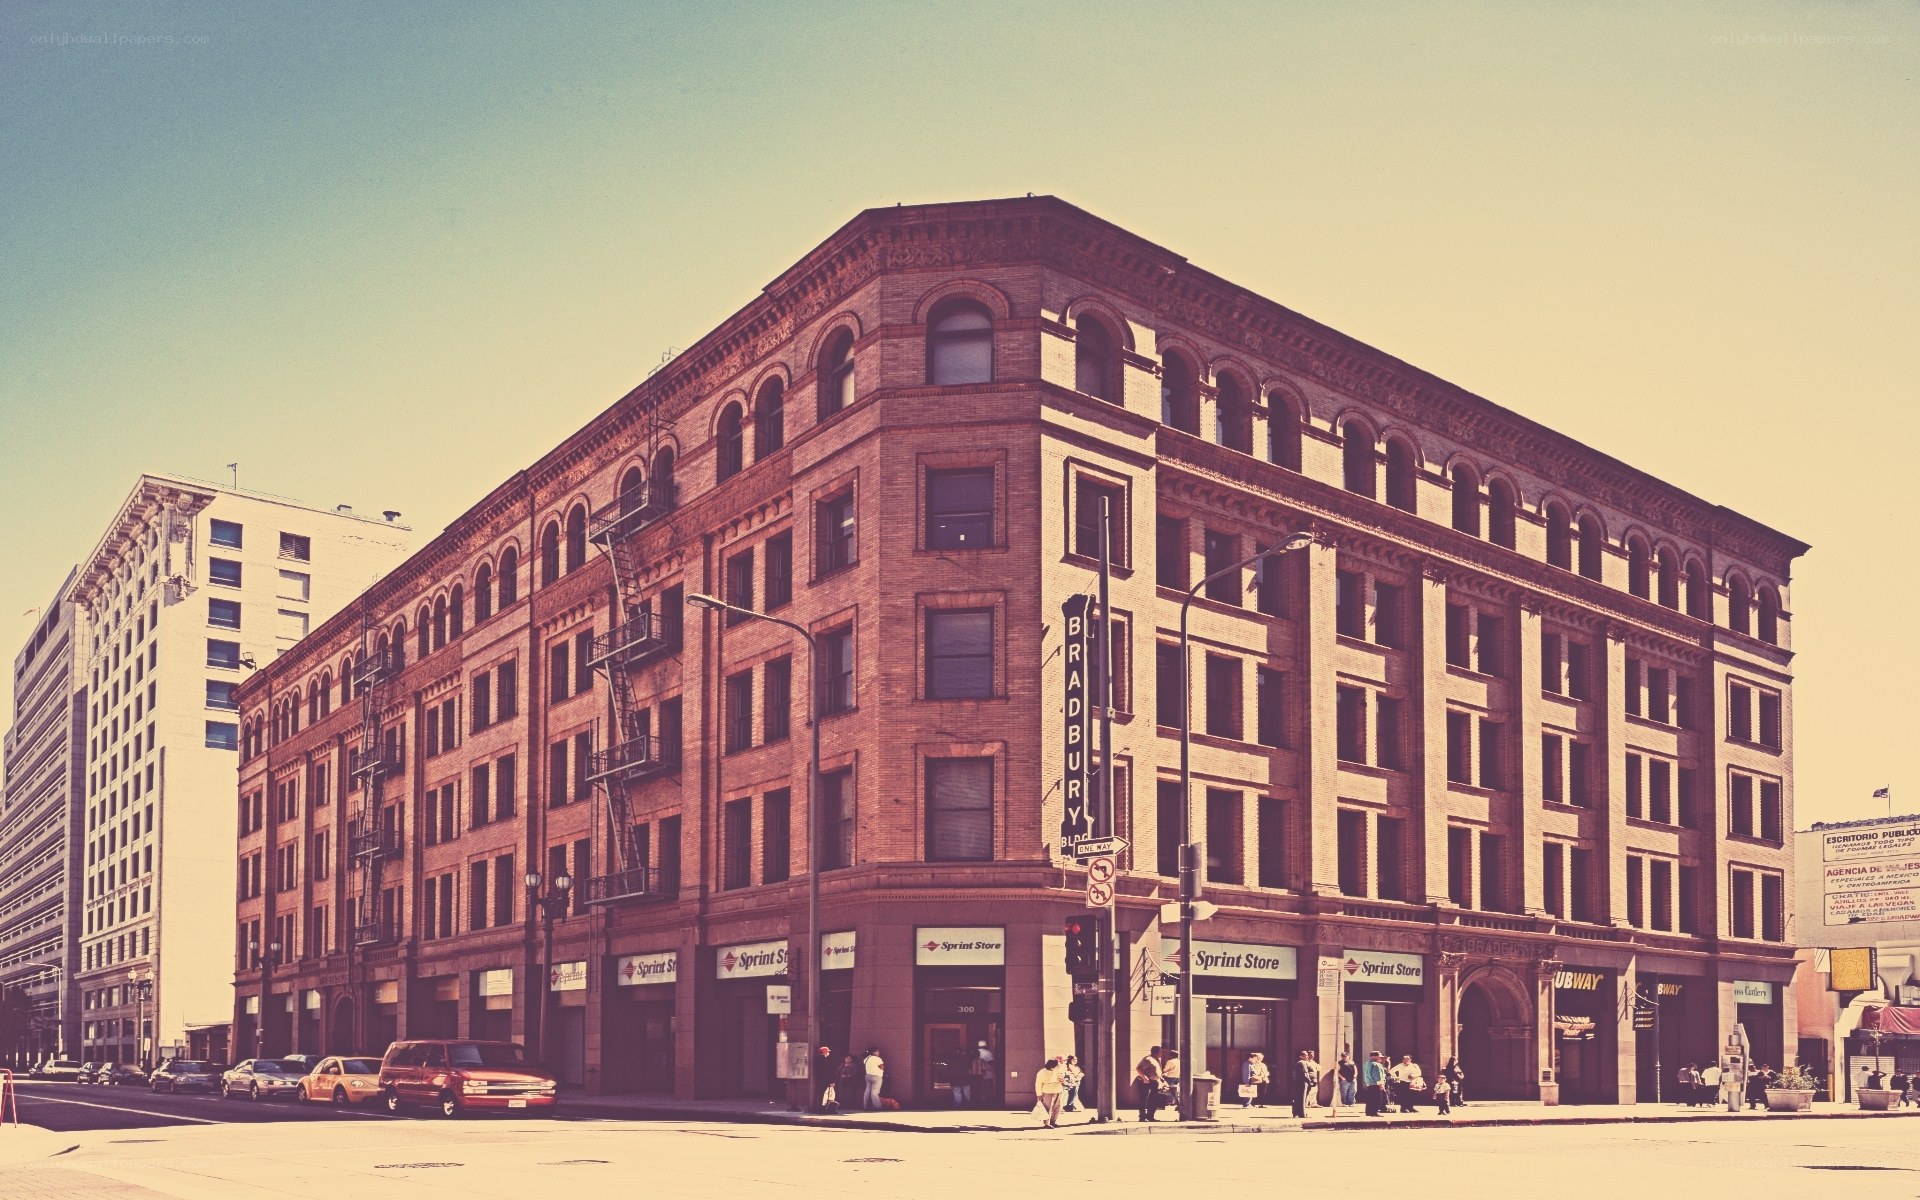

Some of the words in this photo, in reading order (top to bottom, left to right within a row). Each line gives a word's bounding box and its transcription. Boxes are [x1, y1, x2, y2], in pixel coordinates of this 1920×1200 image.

[1068, 616, 1081, 826] BRADBURY
[1827, 832, 1878, 844] ESCRITORIO
[1883, 828, 1920, 838] PUBLICO
[1080, 845, 1094, 853] ONE
[1097, 843, 1111, 851] WAY
[1827, 867, 1867, 877] AGENCIA
[833, 946, 849, 955] Sprint
[941, 941, 973, 951] Sprint
[975, 941, 1001, 950] Store
[739, 950, 776, 970] Sprint
[1195, 950, 1242, 970] Sprint
[1244, 953, 1279, 970] Store
[637, 959, 666, 978] Sprint
[1362, 961, 1395, 976] Sprint
[1396, 963, 1421, 976] Store
[1554, 971, 1604, 990] UBWAY
[1657, 983, 1683, 996] BWAY
